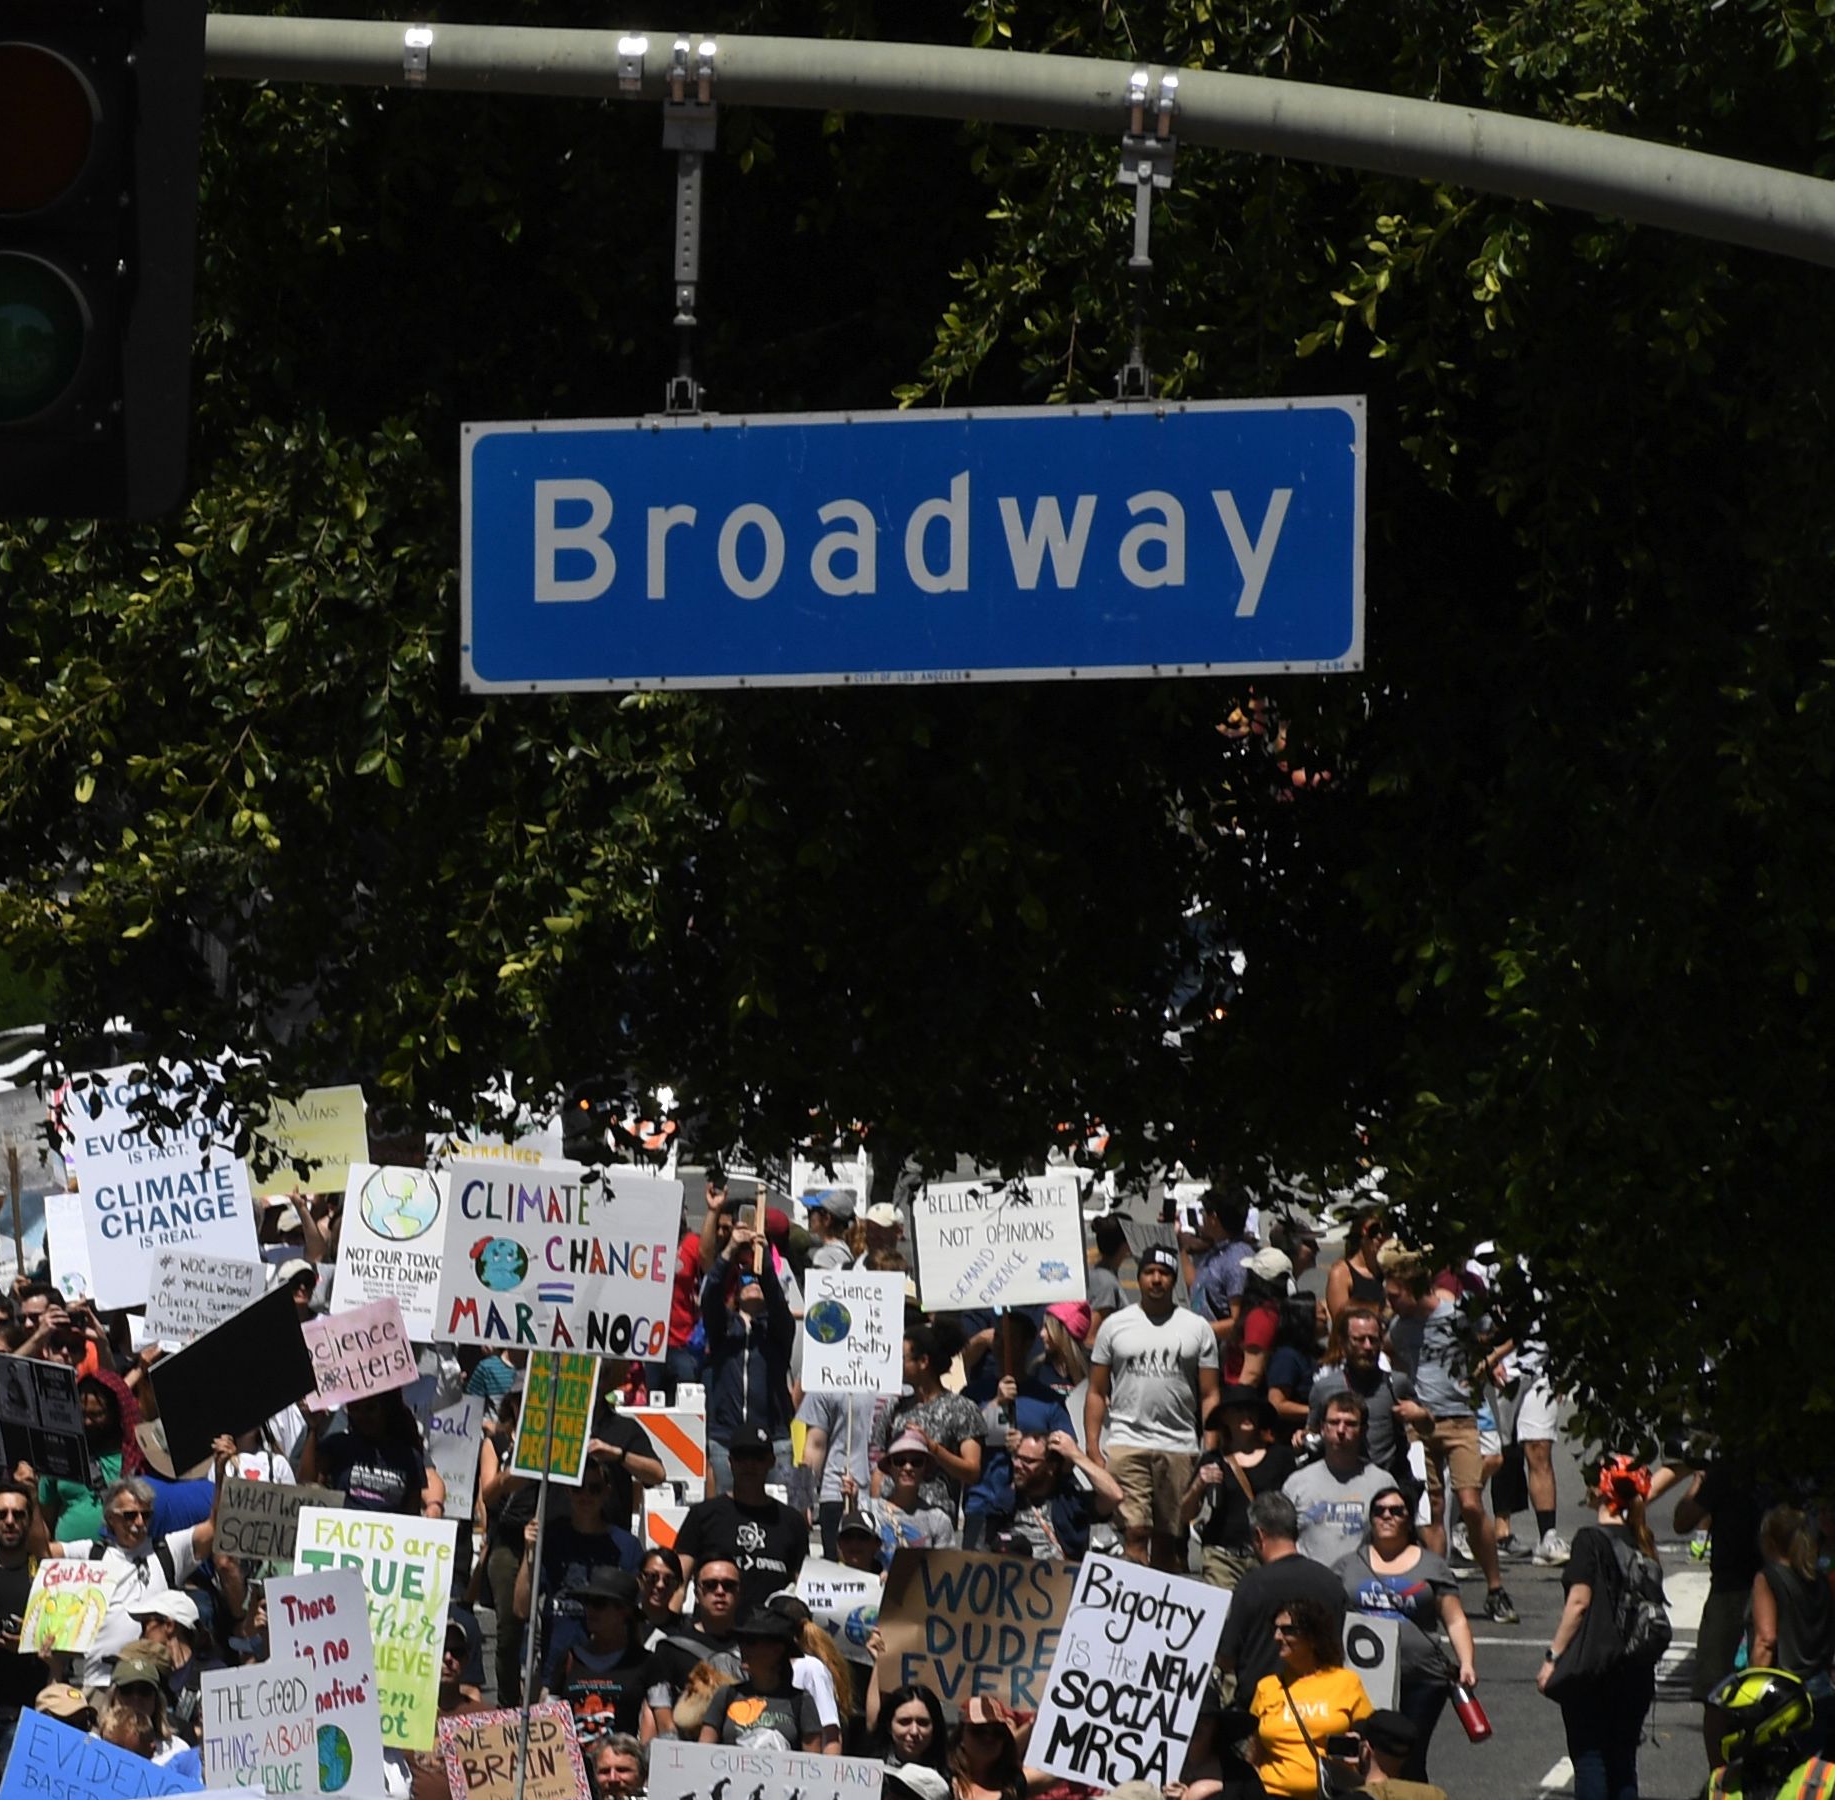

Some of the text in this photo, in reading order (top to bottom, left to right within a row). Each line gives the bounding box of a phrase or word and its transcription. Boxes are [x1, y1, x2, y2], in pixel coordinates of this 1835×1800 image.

[534, 468, 1294, 619] Broadway
[128, 1146, 189, 1165] IS FACT.
[95, 1165, 234, 1212] CLIMATE
[461, 1179, 591, 1225] CLIMATE
[101, 1193, 237, 1239] CHANGE
[139, 1229, 202, 1249] IS REAL.
[545, 1236, 667, 1283] CHANGE
[818, 1275, 883, 1301] Science
[869, 1303, 881, 1319] is
[847, 1335, 892, 1362] Poetry
[865, 1322, 884, 1335] the
[821, 1366, 881, 1391] Reality
[848, 1357, 863, 1370] of
[1071, 1562, 1207, 1650] Bigotry
[1141, 1651, 1209, 1700] NEW
[1051, 1670, 1189, 1743] SOCIAL
[1044, 1714, 1169, 1788] MRSA
